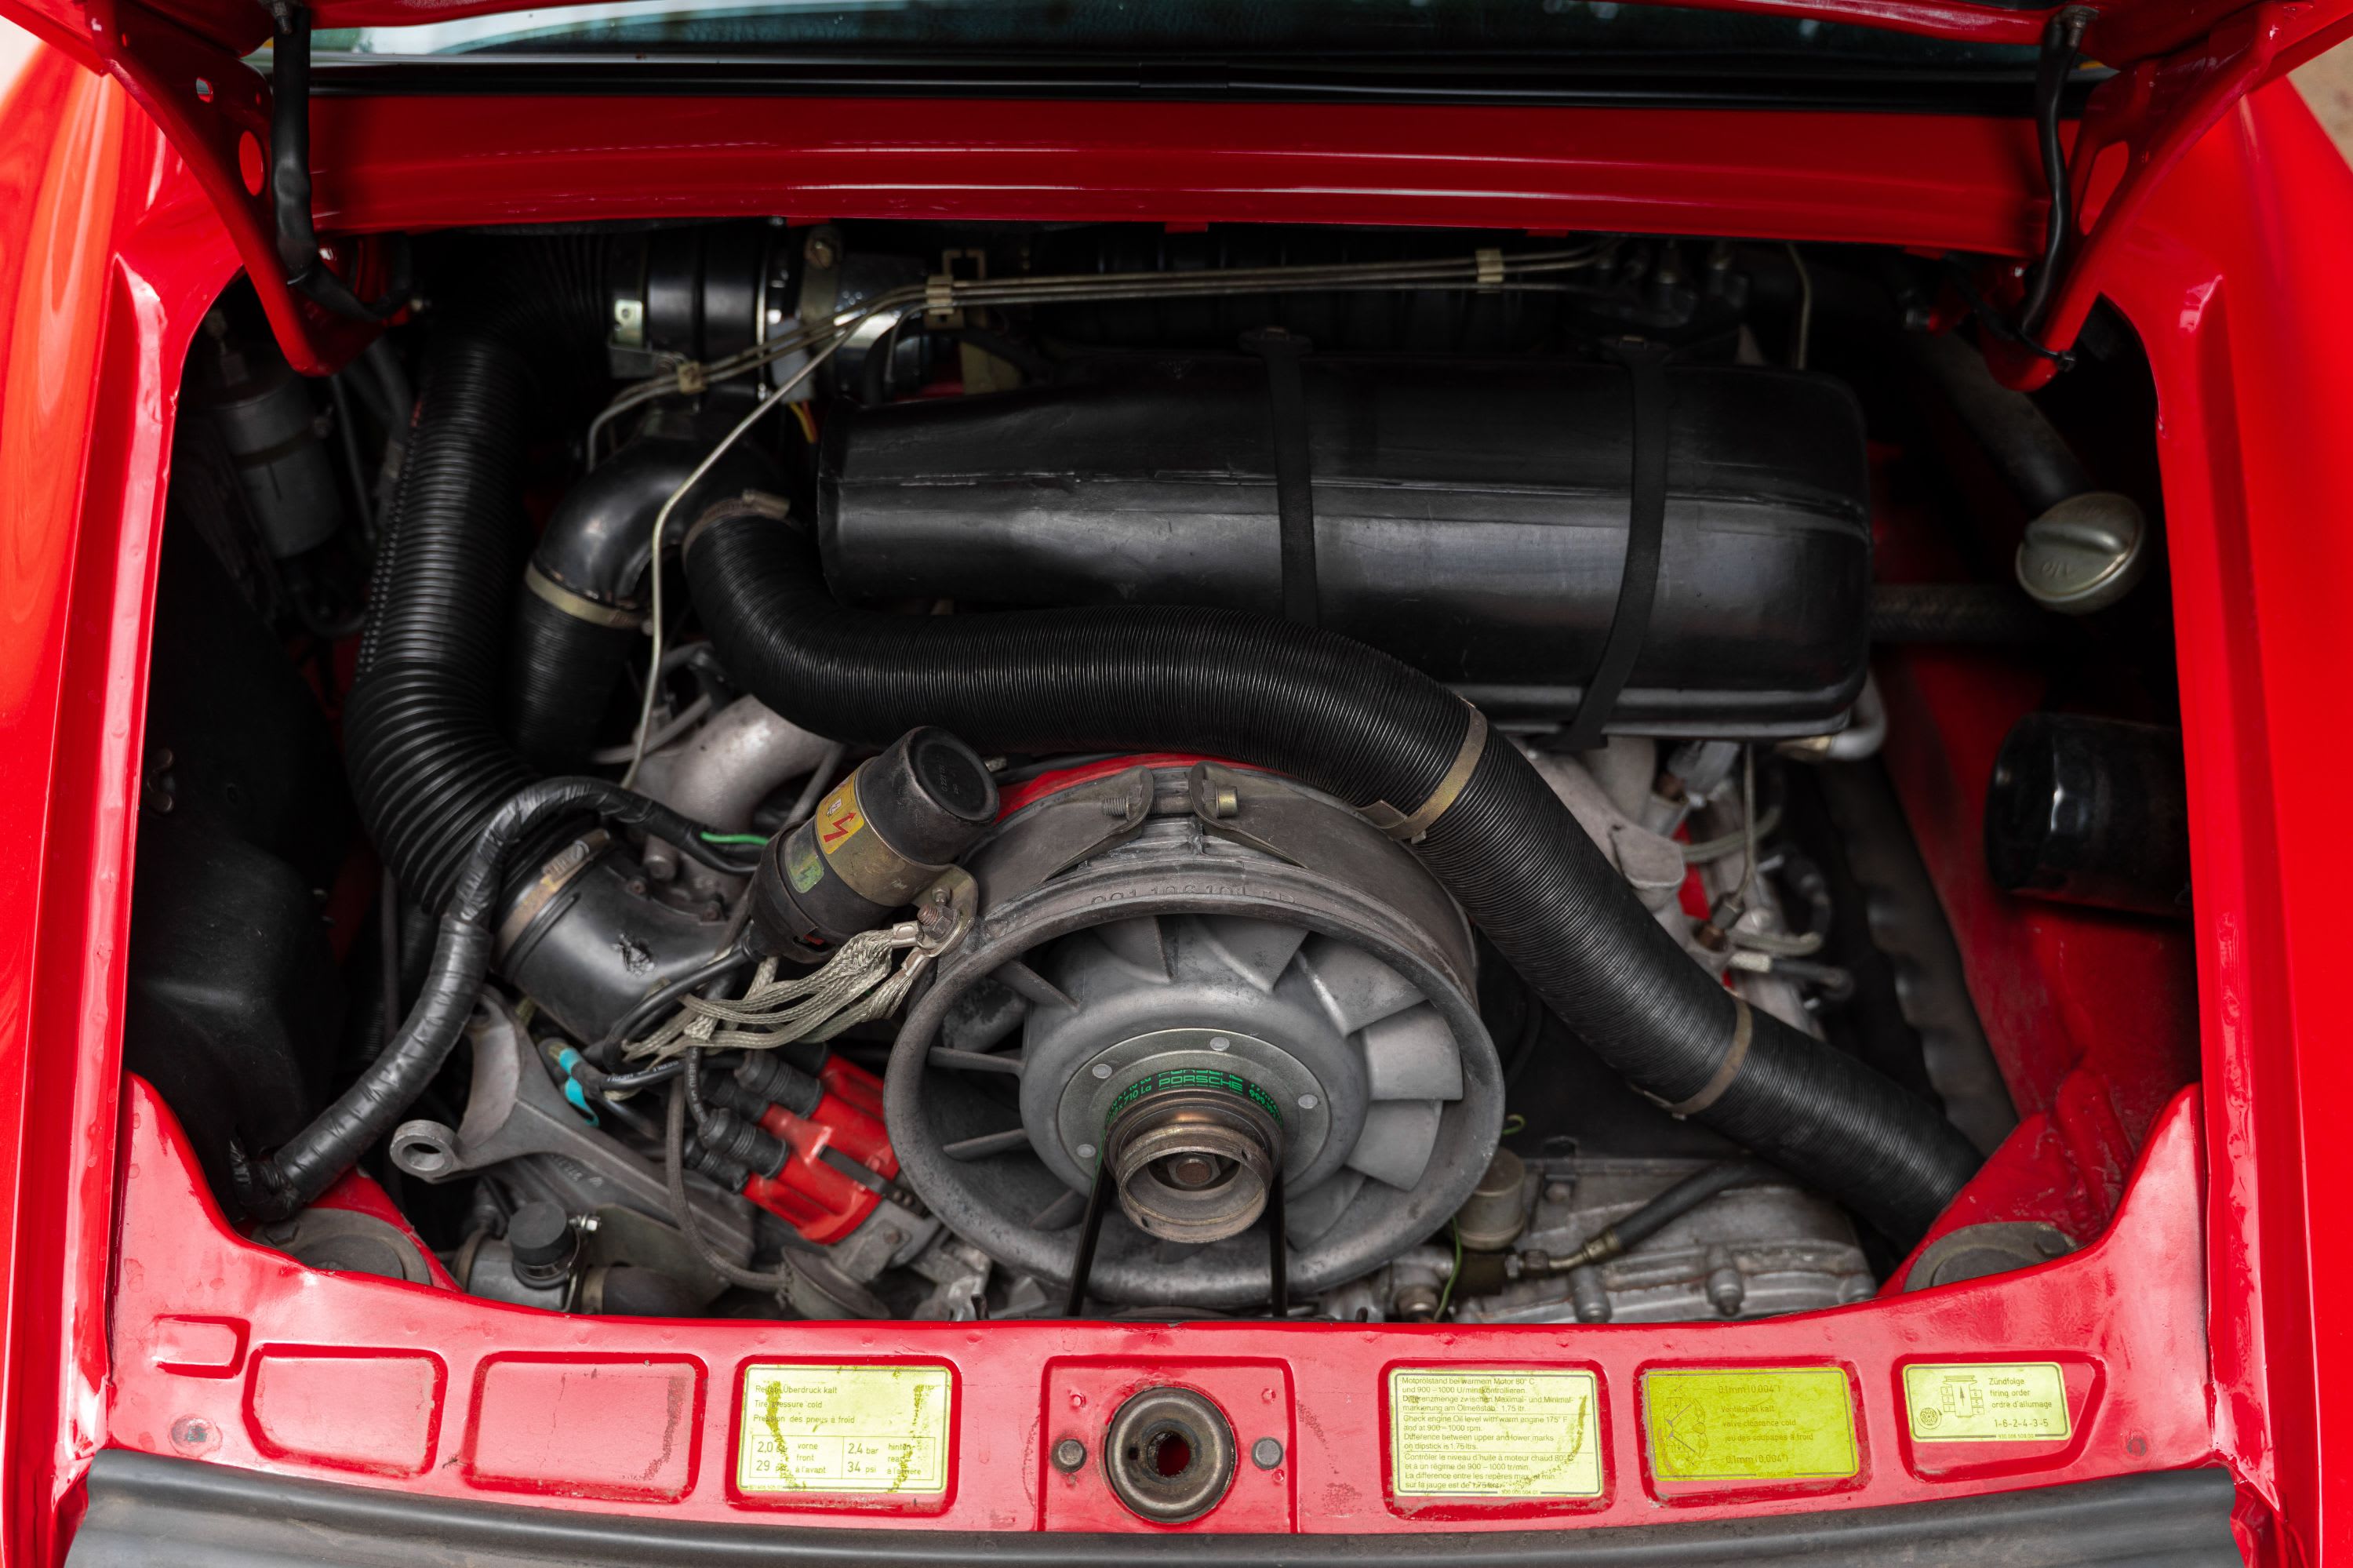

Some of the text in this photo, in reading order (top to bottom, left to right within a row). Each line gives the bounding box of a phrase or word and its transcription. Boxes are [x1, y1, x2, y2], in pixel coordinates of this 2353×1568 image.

[1158, 1075, 1243, 1092] PORSCHE
[1988, 1377, 2024, 1386] Zündfolge
[1990, 1389, 2009, 1398] firing
[755, 1399, 768, 1408] Tire
[1402, 1395, 1459, 1403] Differenzmenge
[838, 1415, 855, 1424] froid
[1737, 1433, 1751, 1442] des
[1752, 1433, 1788, 1442] soupapes
[756, 1460, 770, 1472] 29
[847, 1461, 860, 1472] 34
